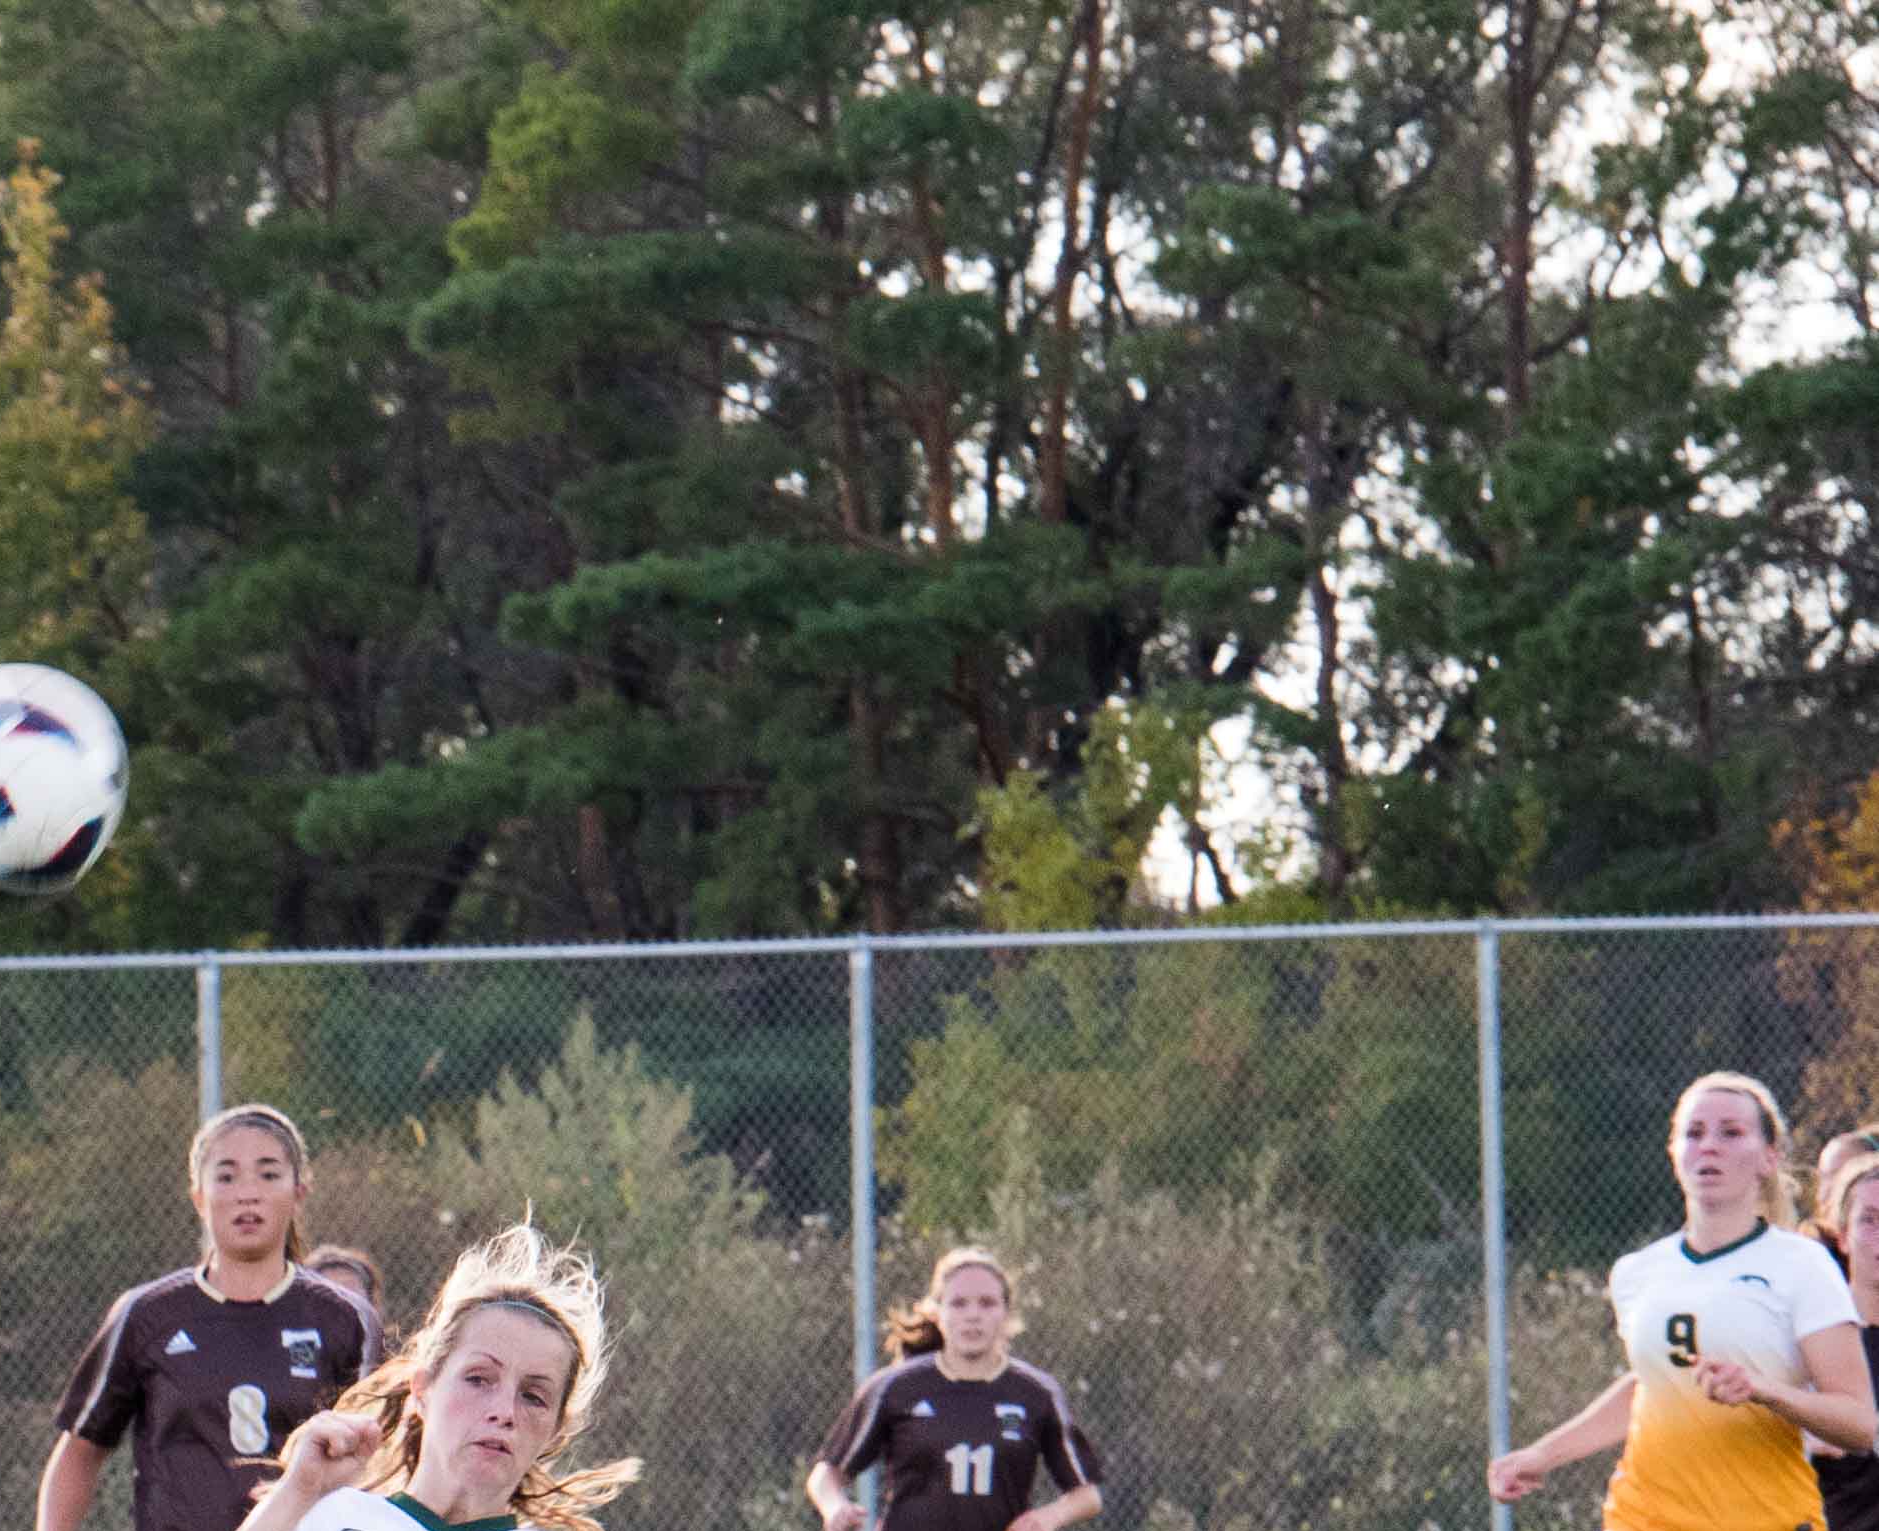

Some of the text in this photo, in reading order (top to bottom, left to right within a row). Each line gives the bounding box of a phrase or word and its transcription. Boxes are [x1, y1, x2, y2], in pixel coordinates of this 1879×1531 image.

[1666, 1312, 1698, 1368] 9
[228, 1384, 270, 1455] 8
[944, 1442, 994, 1496] 11
